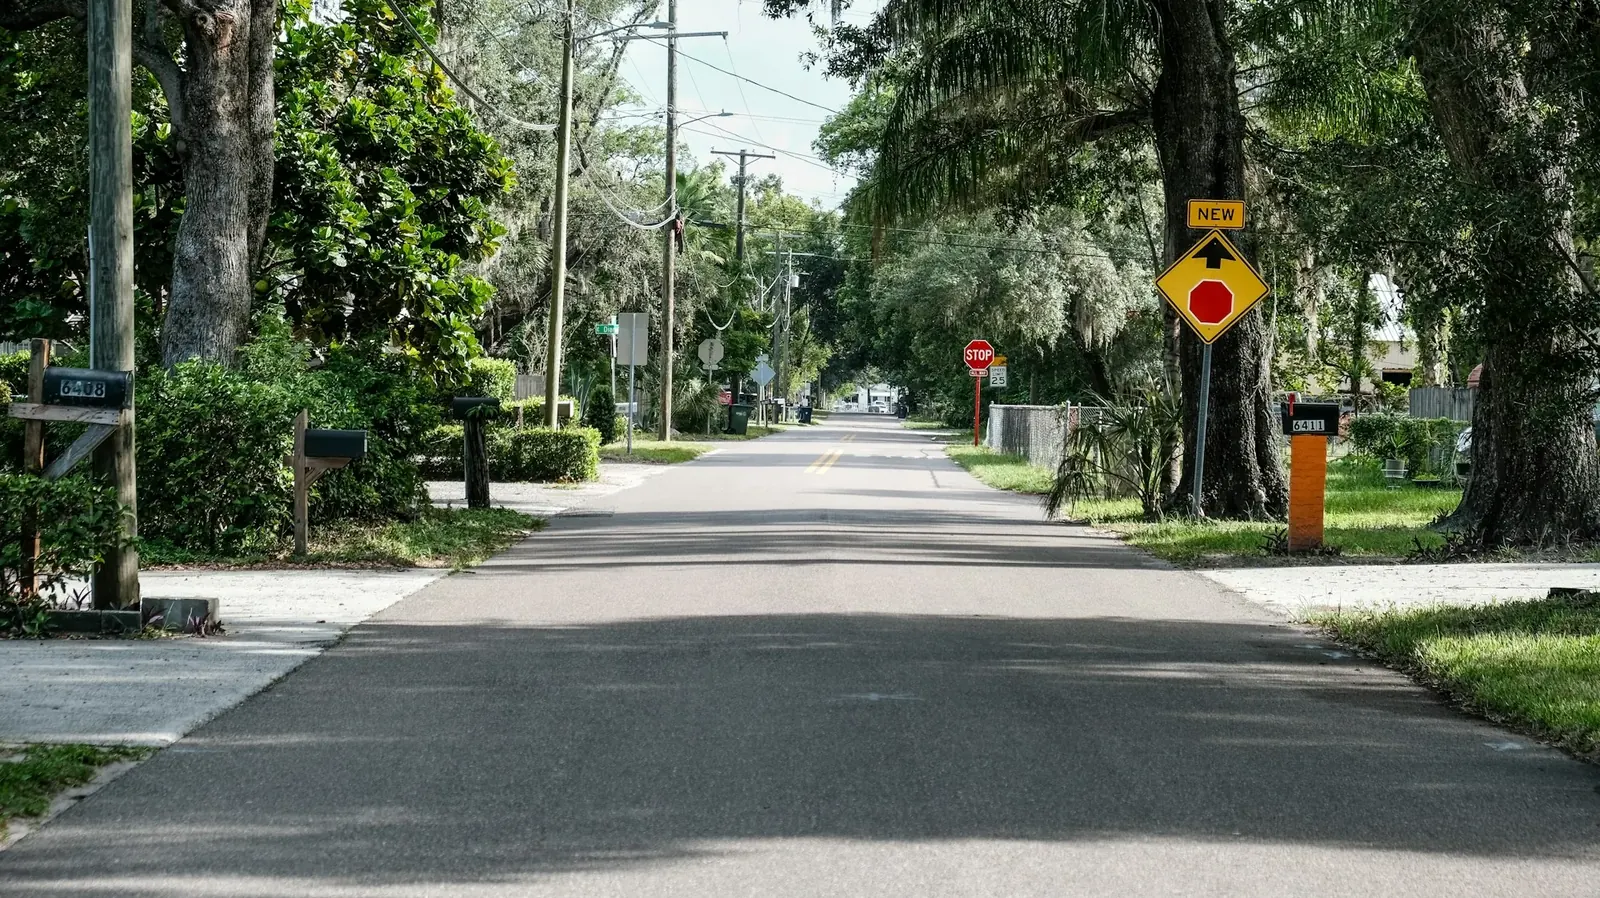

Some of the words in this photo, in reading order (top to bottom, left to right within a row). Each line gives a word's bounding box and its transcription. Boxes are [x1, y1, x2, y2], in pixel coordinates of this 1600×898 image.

[1198, 207, 1234, 221] NEW
[966, 349, 992, 361] STOP
[992, 376, 1005, 385] 25
[62, 380, 104, 397] 6408
[1294, 420, 1323, 430] 6411
